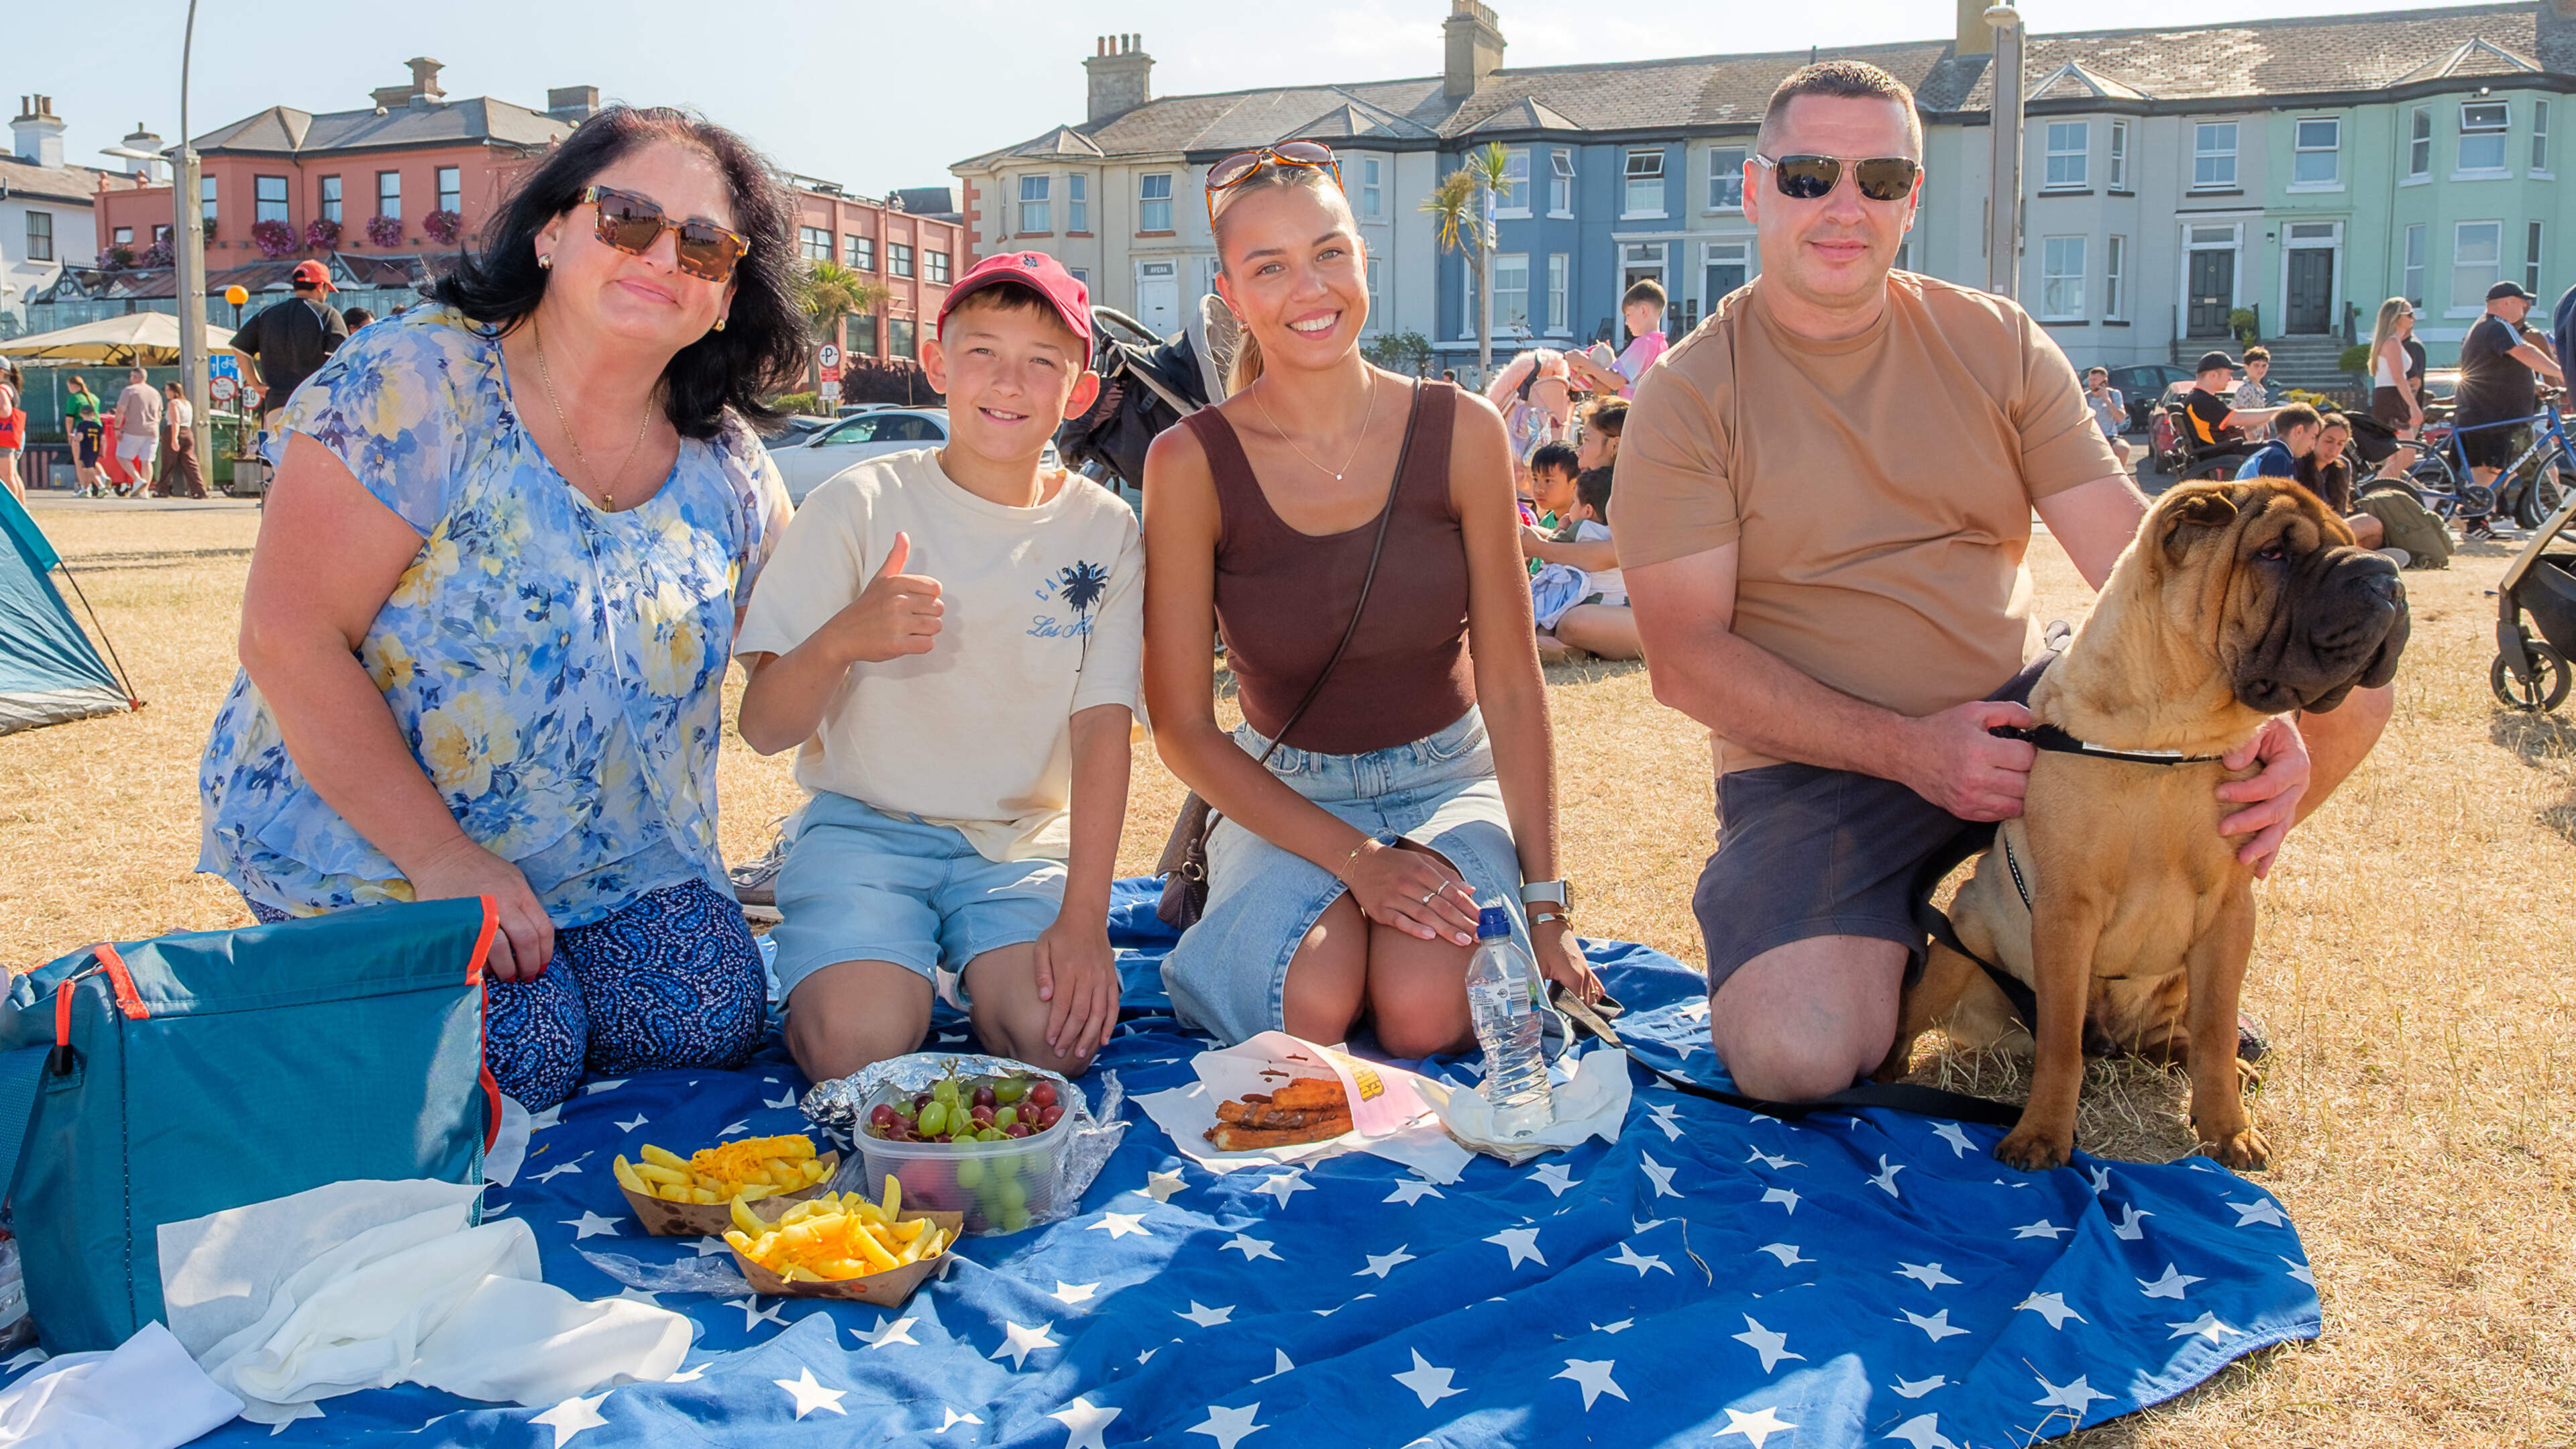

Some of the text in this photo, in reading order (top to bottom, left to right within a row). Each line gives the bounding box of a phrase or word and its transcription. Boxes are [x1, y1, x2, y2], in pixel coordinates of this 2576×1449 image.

[244, 389, 256, 400] 50
[88, 433, 98, 451] 7
[2506, 443, 2538, 474] GIANT
[1026, 614, 1061, 638] Los
